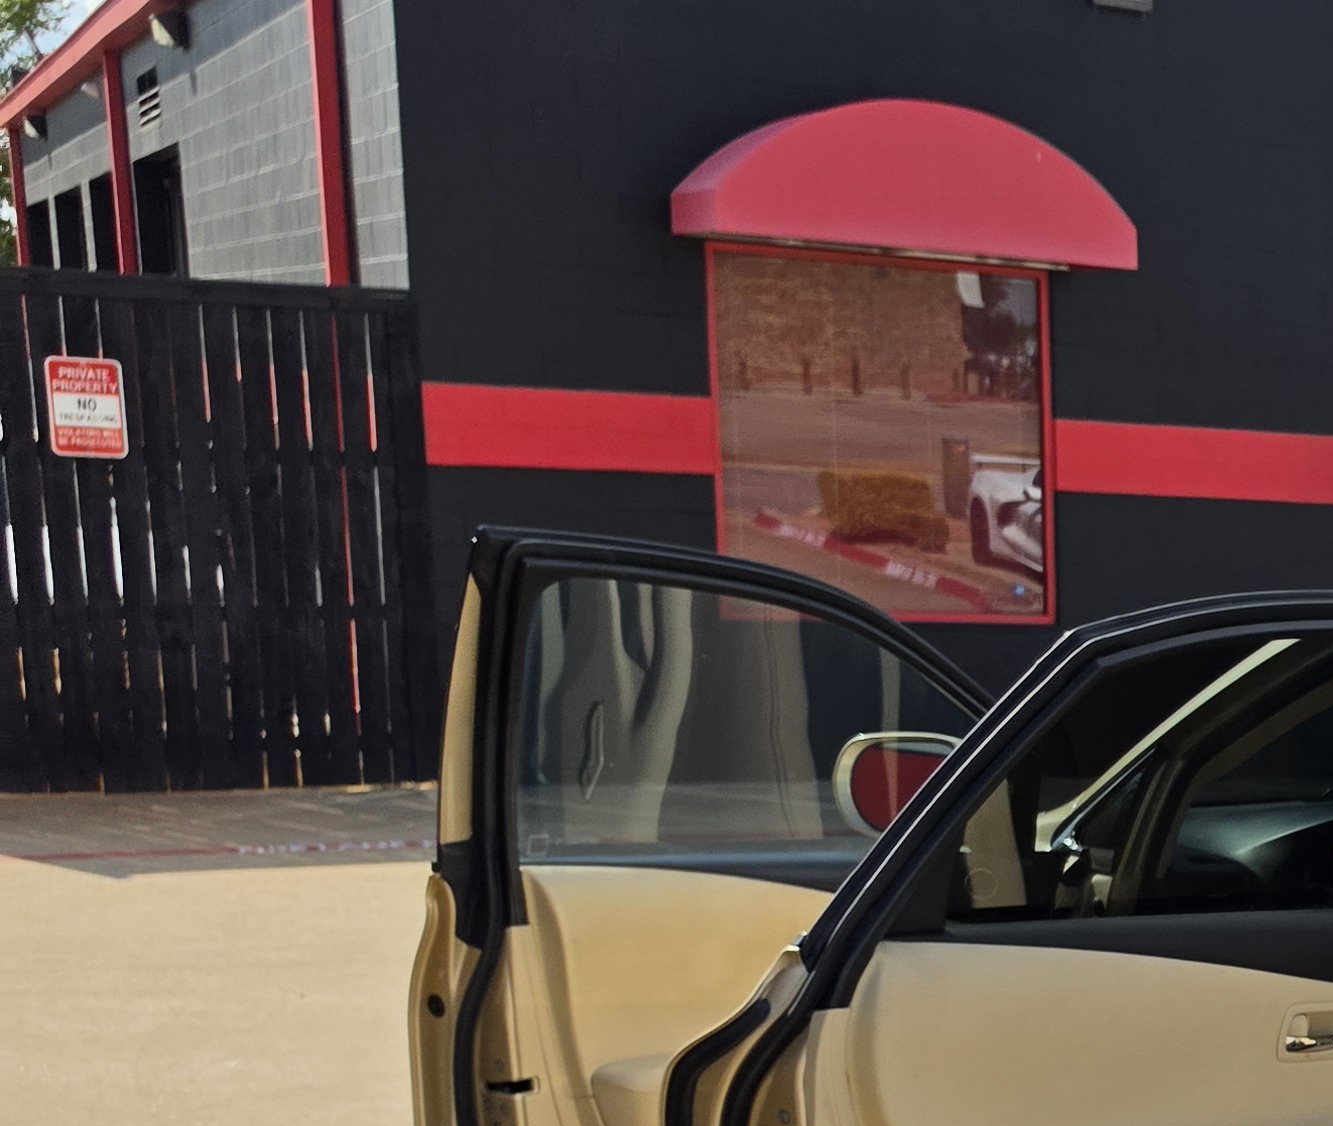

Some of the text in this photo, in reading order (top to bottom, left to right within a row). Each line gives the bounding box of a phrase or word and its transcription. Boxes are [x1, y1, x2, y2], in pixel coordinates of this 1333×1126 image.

[58, 366, 110, 381] PRIVATE
[53, 378, 118, 394] PROPERTY
[77, 398, 97, 412] NO
